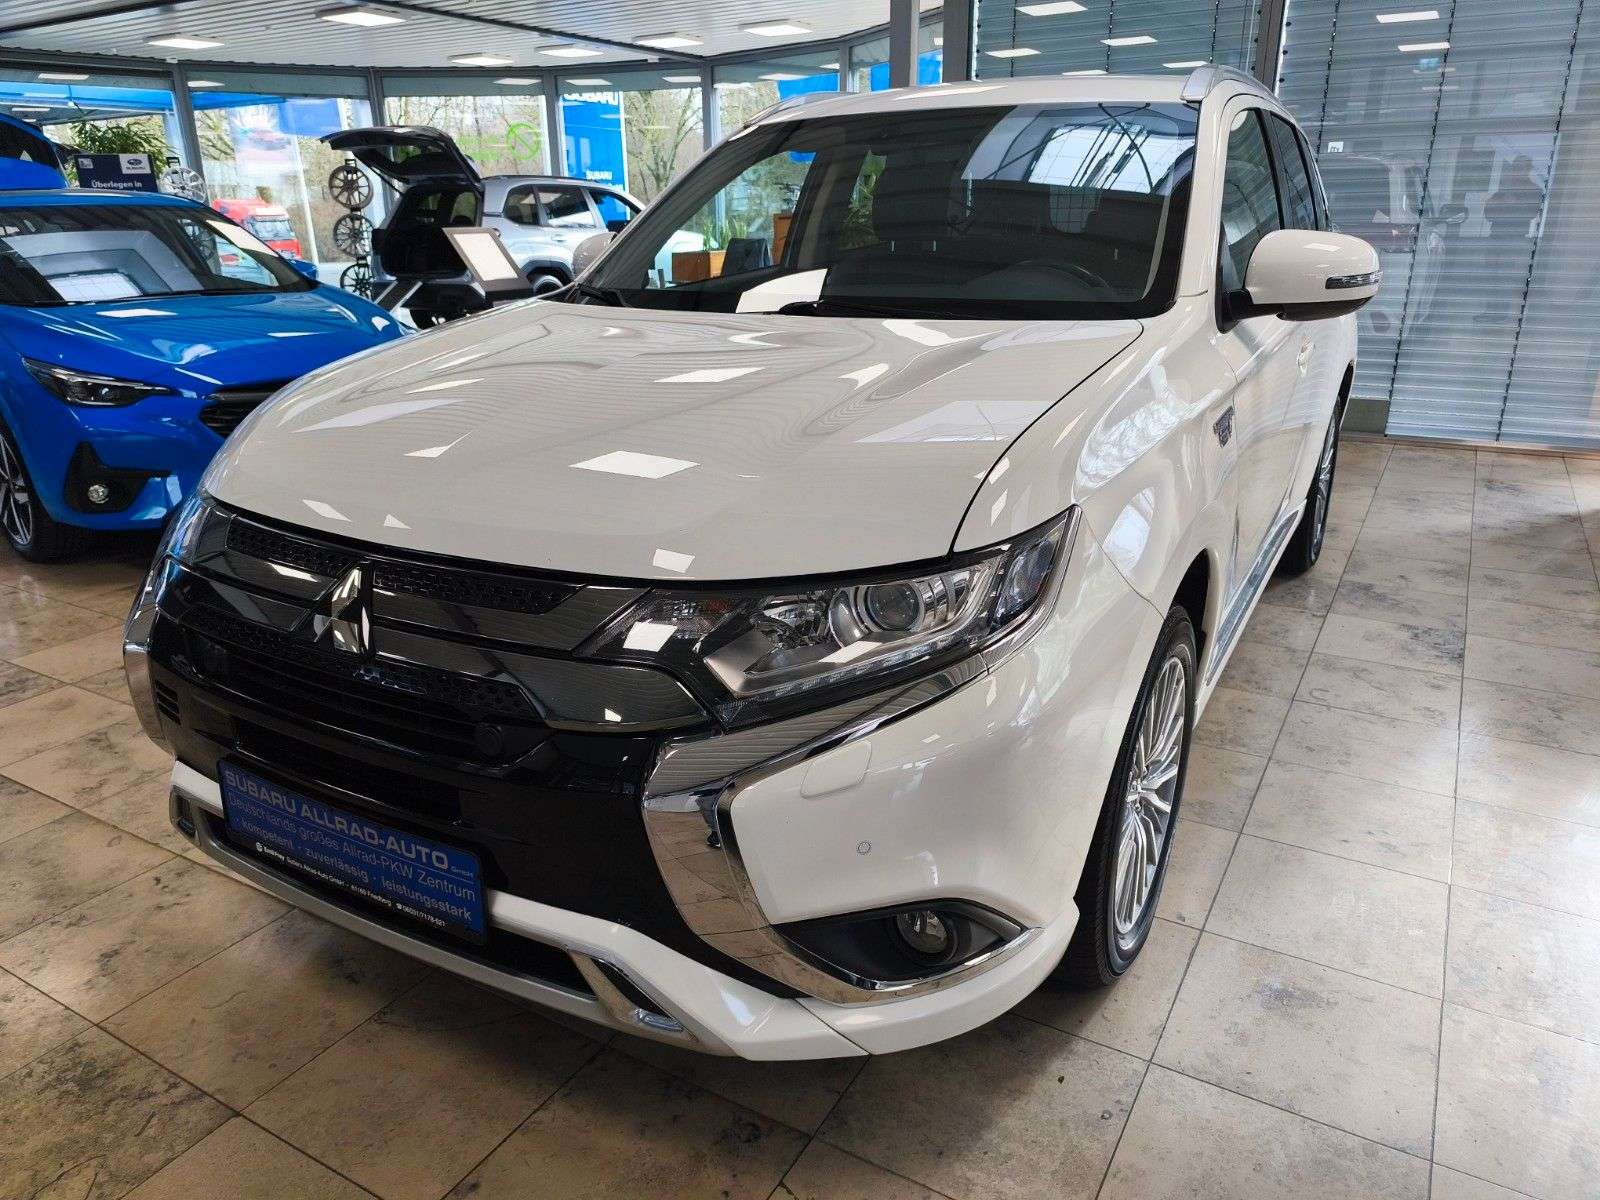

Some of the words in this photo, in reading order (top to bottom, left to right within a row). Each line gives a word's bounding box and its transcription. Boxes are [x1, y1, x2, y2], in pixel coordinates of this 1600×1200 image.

[91, 180, 133, 189] Überlegen
[135, 180, 143, 188] in
[224, 769, 297, 814] SUBARU
[301, 803, 449, 870] ALLRAD-AUTO
[240, 820, 294, 851] kompetent
[381, 875, 472, 921] leistungsstark
[342, 841, 413, 879] Allrad-PKW
[417, 868, 476, 901] Zentrum
